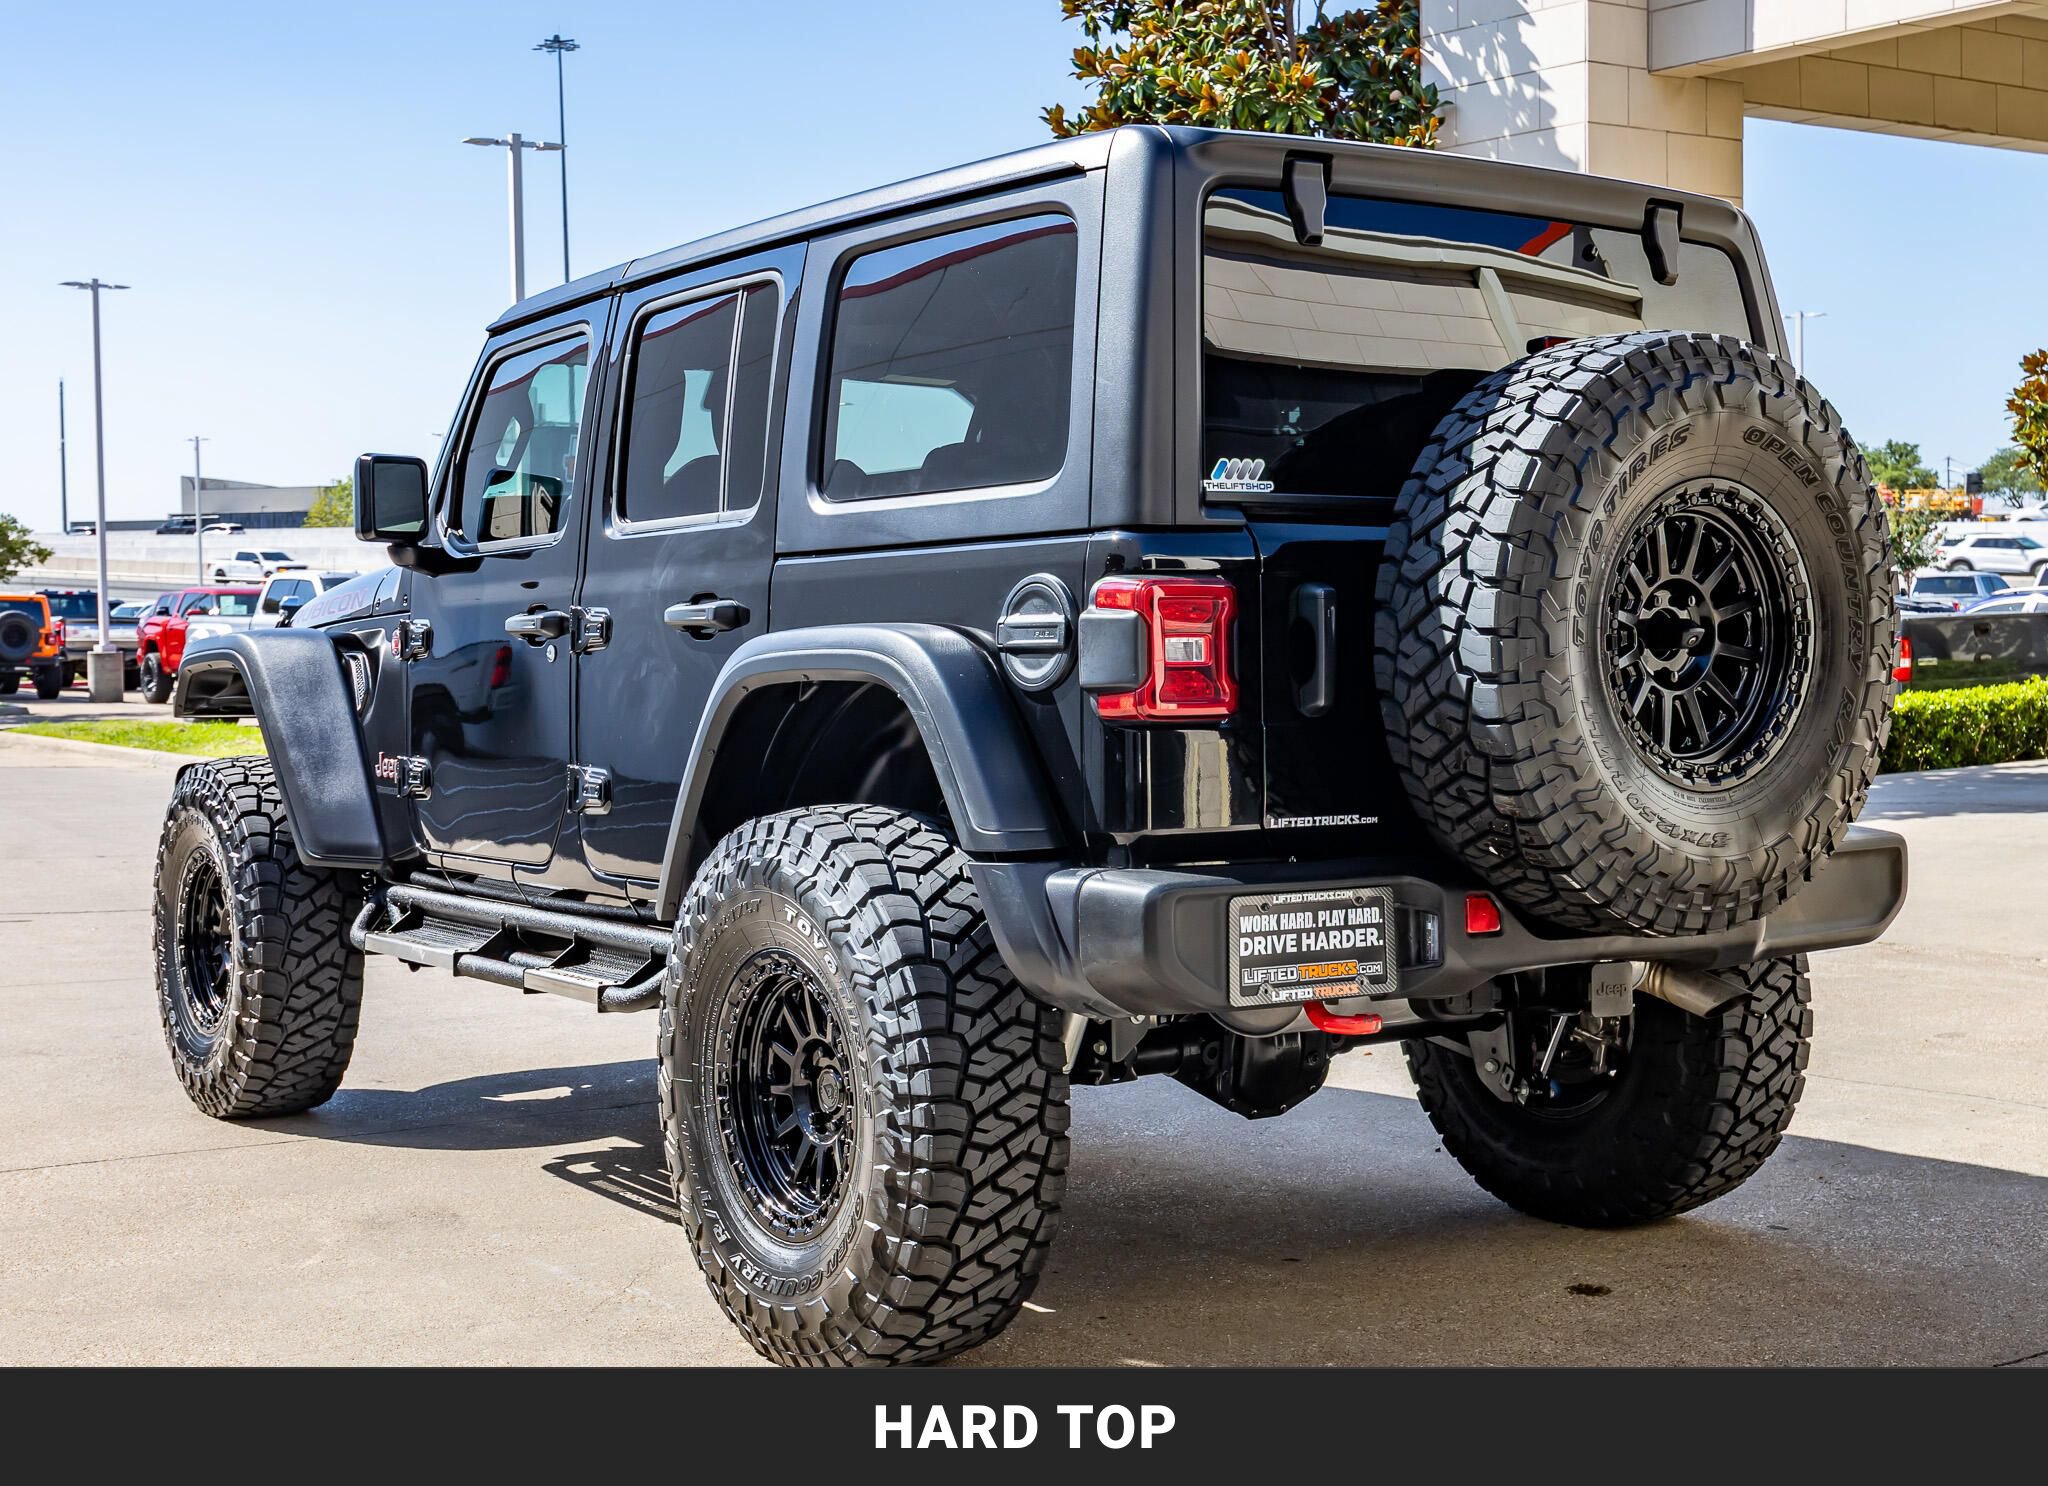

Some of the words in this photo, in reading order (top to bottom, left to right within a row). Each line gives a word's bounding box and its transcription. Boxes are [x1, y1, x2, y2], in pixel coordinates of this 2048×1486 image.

[1205, 481, 1273, 491] THELIFTSHOP
[1573, 518, 1603, 648] TOYO
[1603, 424, 1692, 517] TIRES
[1743, 425, 1822, 488] OPEN
[1815, 491, 1866, 676] COUNTRY
[1239, 914, 1279, 934] WORK
[1279, 911, 1316, 931] HARD.
[1318, 908, 1346, 928] PLAY
[1347, 907, 1383, 925] HARD.
[784, 903, 838, 975] TOYO
[1239, 934, 1298, 957] DRIVE
[1301, 928, 1384, 952] HARDER.
[1596, 981, 1627, 997] Jeep
[728, 1252, 824, 1296] COUNTRY
